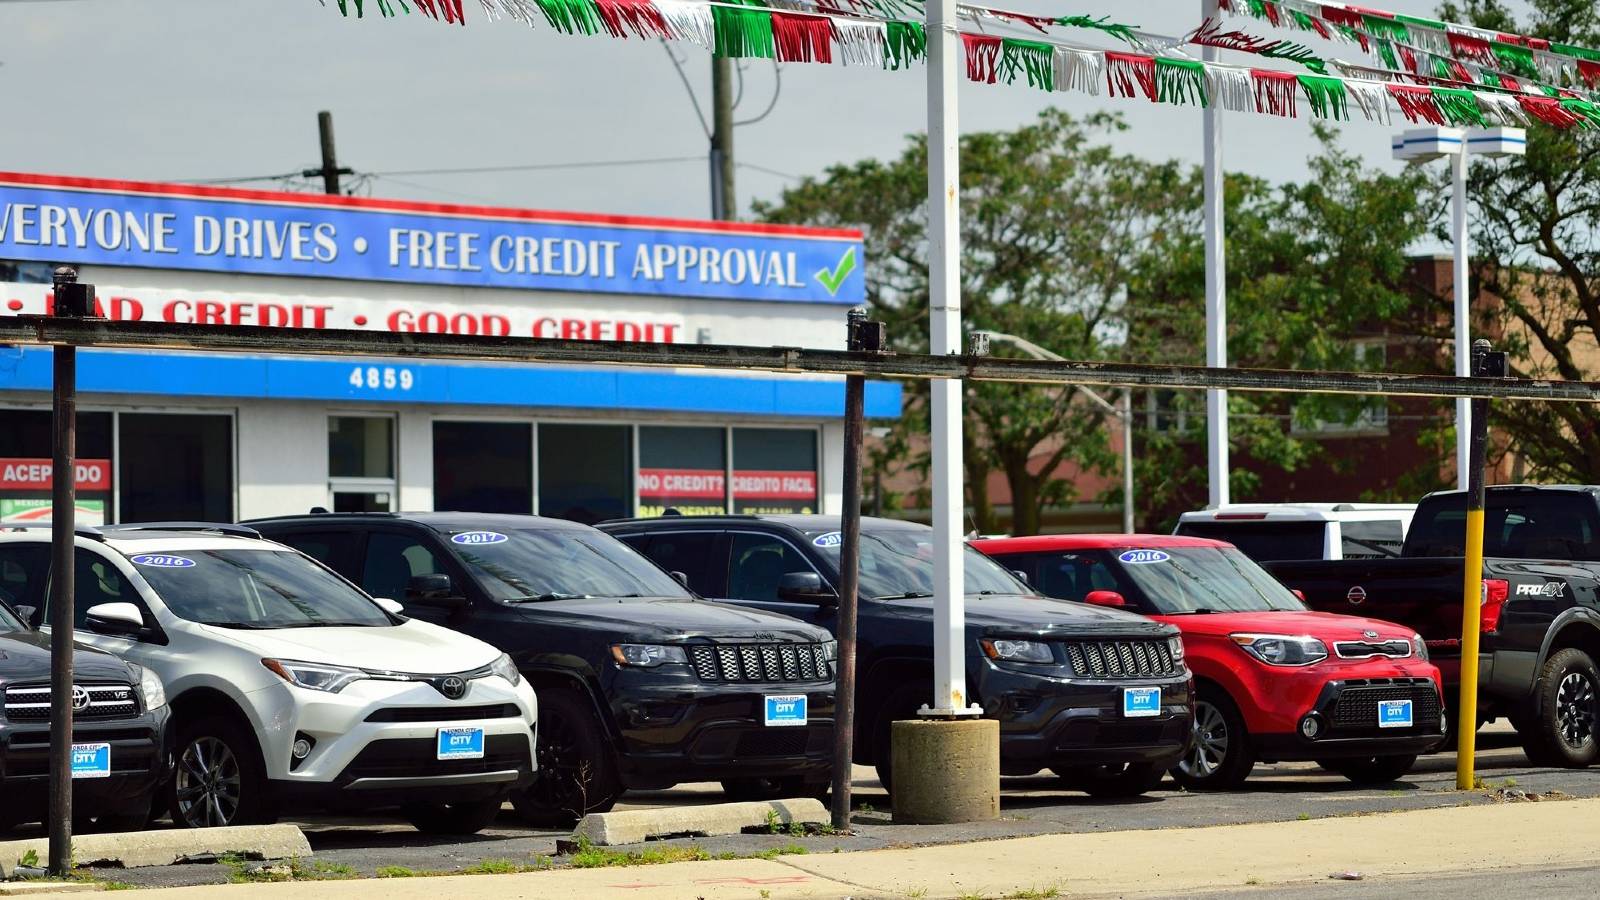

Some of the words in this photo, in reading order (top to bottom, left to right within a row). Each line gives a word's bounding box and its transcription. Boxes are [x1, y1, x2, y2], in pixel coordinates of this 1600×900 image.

[194, 215, 338, 263] DRIVES
[388, 228, 482, 272] FREE
[490, 235, 621, 279] CREDIT
[632, 243, 806, 288] APPROVAL
[162, 300, 333, 329] CREDIT
[387, 310, 511, 336] GOOD
[532, 318, 680, 344] CREDIT
[350, 366, 413, 389] 4859
[3, 464, 101, 482] ACEPDO
[639, 475, 659, 491] NO
[663, 475, 724, 492] CREDIT?
[732, 477, 778, 492] CREDITO
[783, 478, 813, 492] FACIL
[463, 533, 497, 544] 2017
[821, 534, 841, 545] 201
[144, 556, 184, 566] 2016
[1130, 552, 1160, 562] 2016
[114, 691, 128, 699] V6
[776, 704, 795, 713] CITY
[1387, 708, 1403, 716] CITY
[450, 736, 472, 745] CITY
[73, 753, 96, 763] CITY
